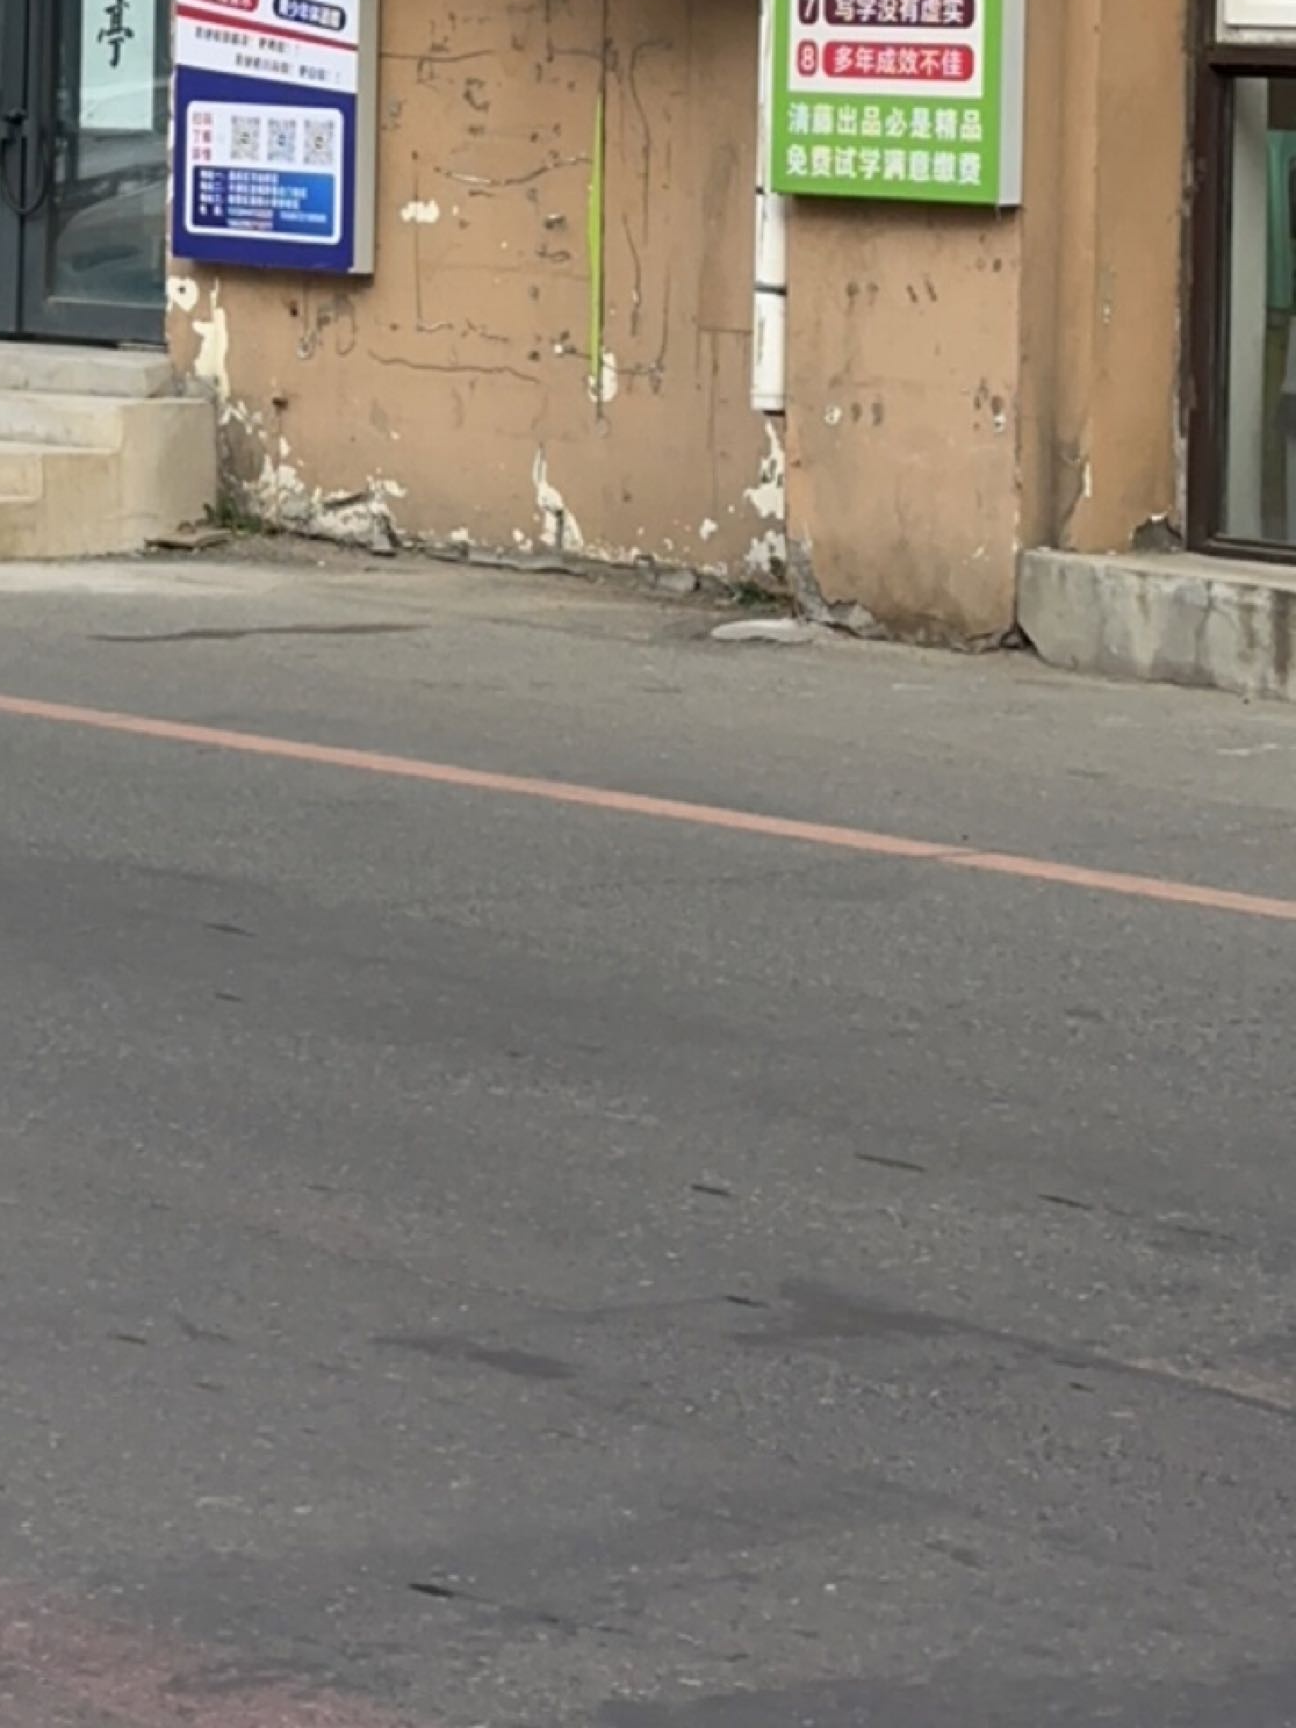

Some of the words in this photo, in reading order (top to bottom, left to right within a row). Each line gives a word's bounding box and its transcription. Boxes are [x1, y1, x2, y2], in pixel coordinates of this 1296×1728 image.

[801, 45, 815, 71] 8
[833, 45, 963, 78] 多年成效不佳
